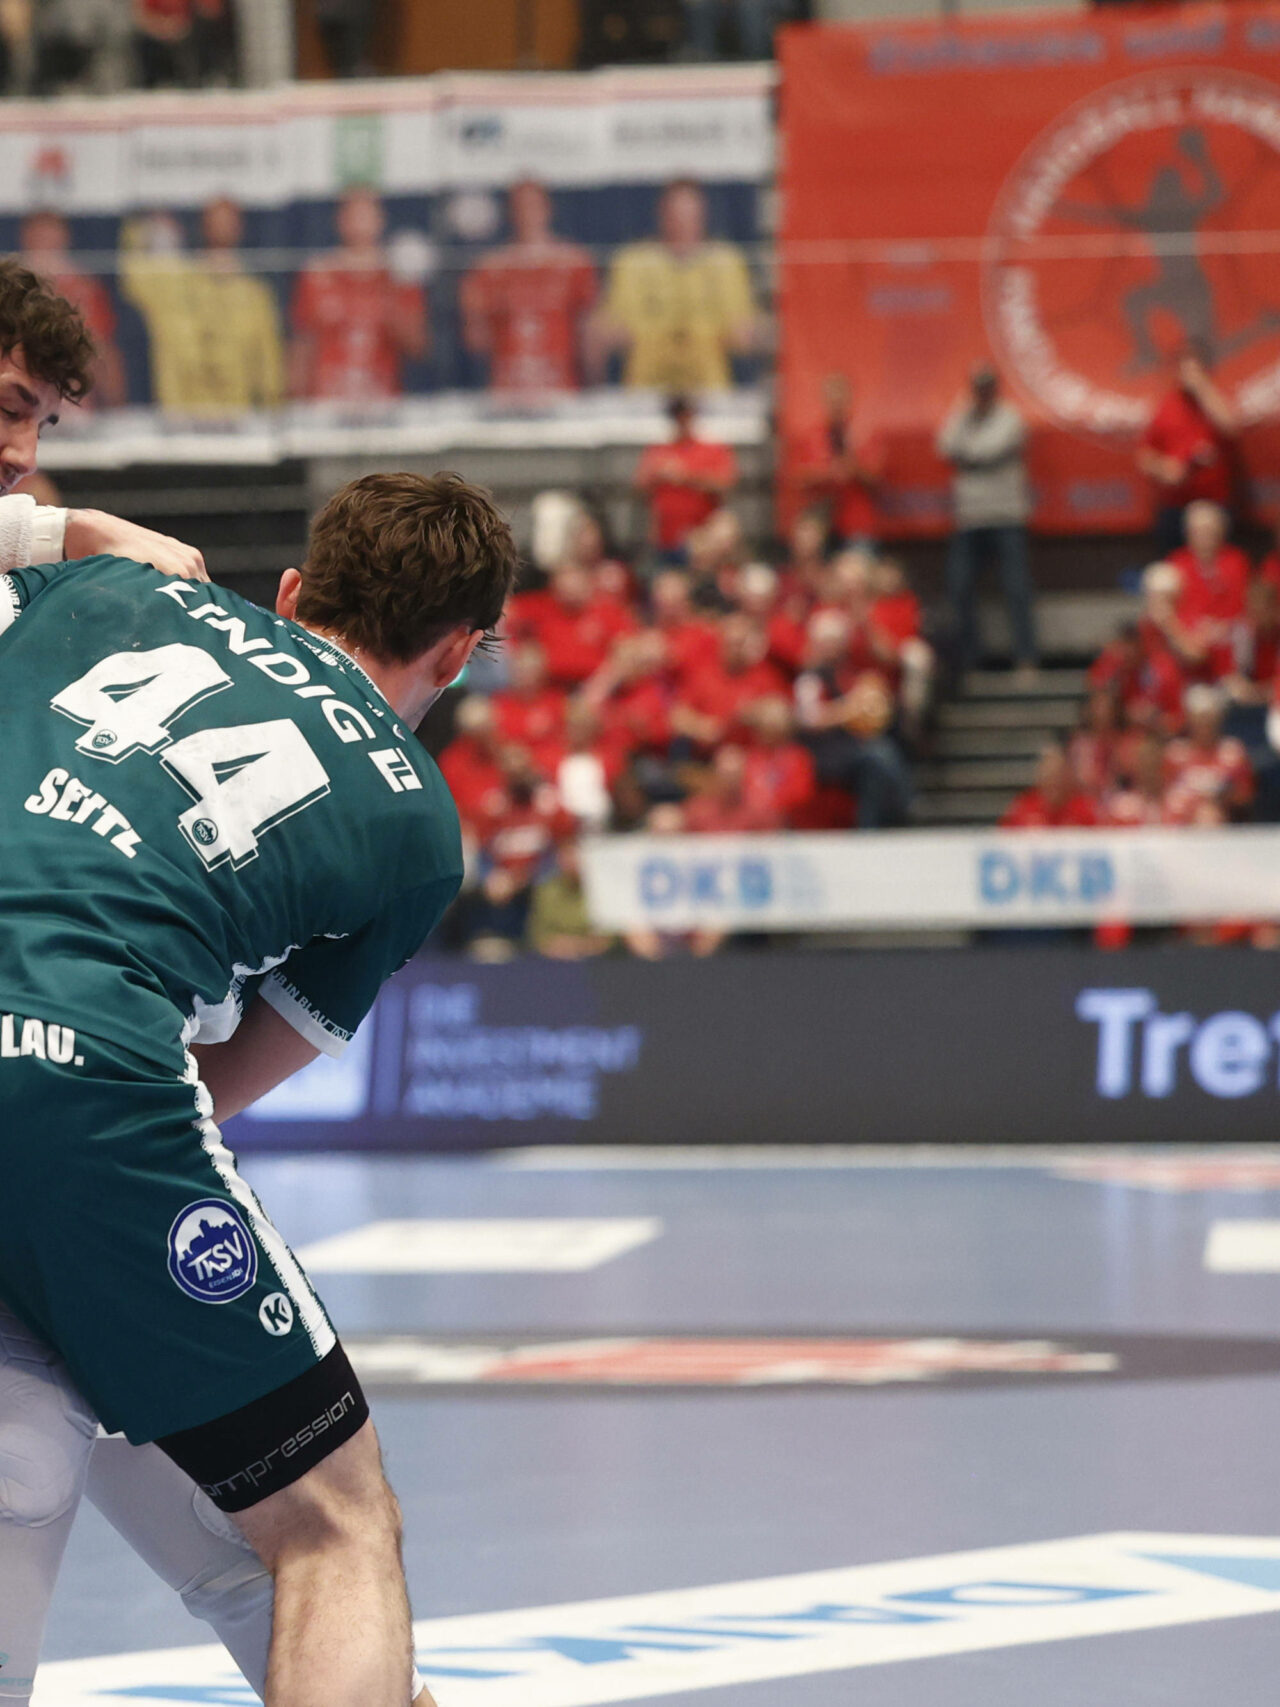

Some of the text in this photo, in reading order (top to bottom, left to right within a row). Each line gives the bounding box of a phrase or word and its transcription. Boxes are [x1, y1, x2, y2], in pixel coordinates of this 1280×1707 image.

[155, 580, 376, 744] LINDIG
[49, 642, 331, 872] 44
[638, 856, 774, 909] DKB
[978, 849, 1116, 906] DKB
[201, 1391, 355, 1497] ompression
